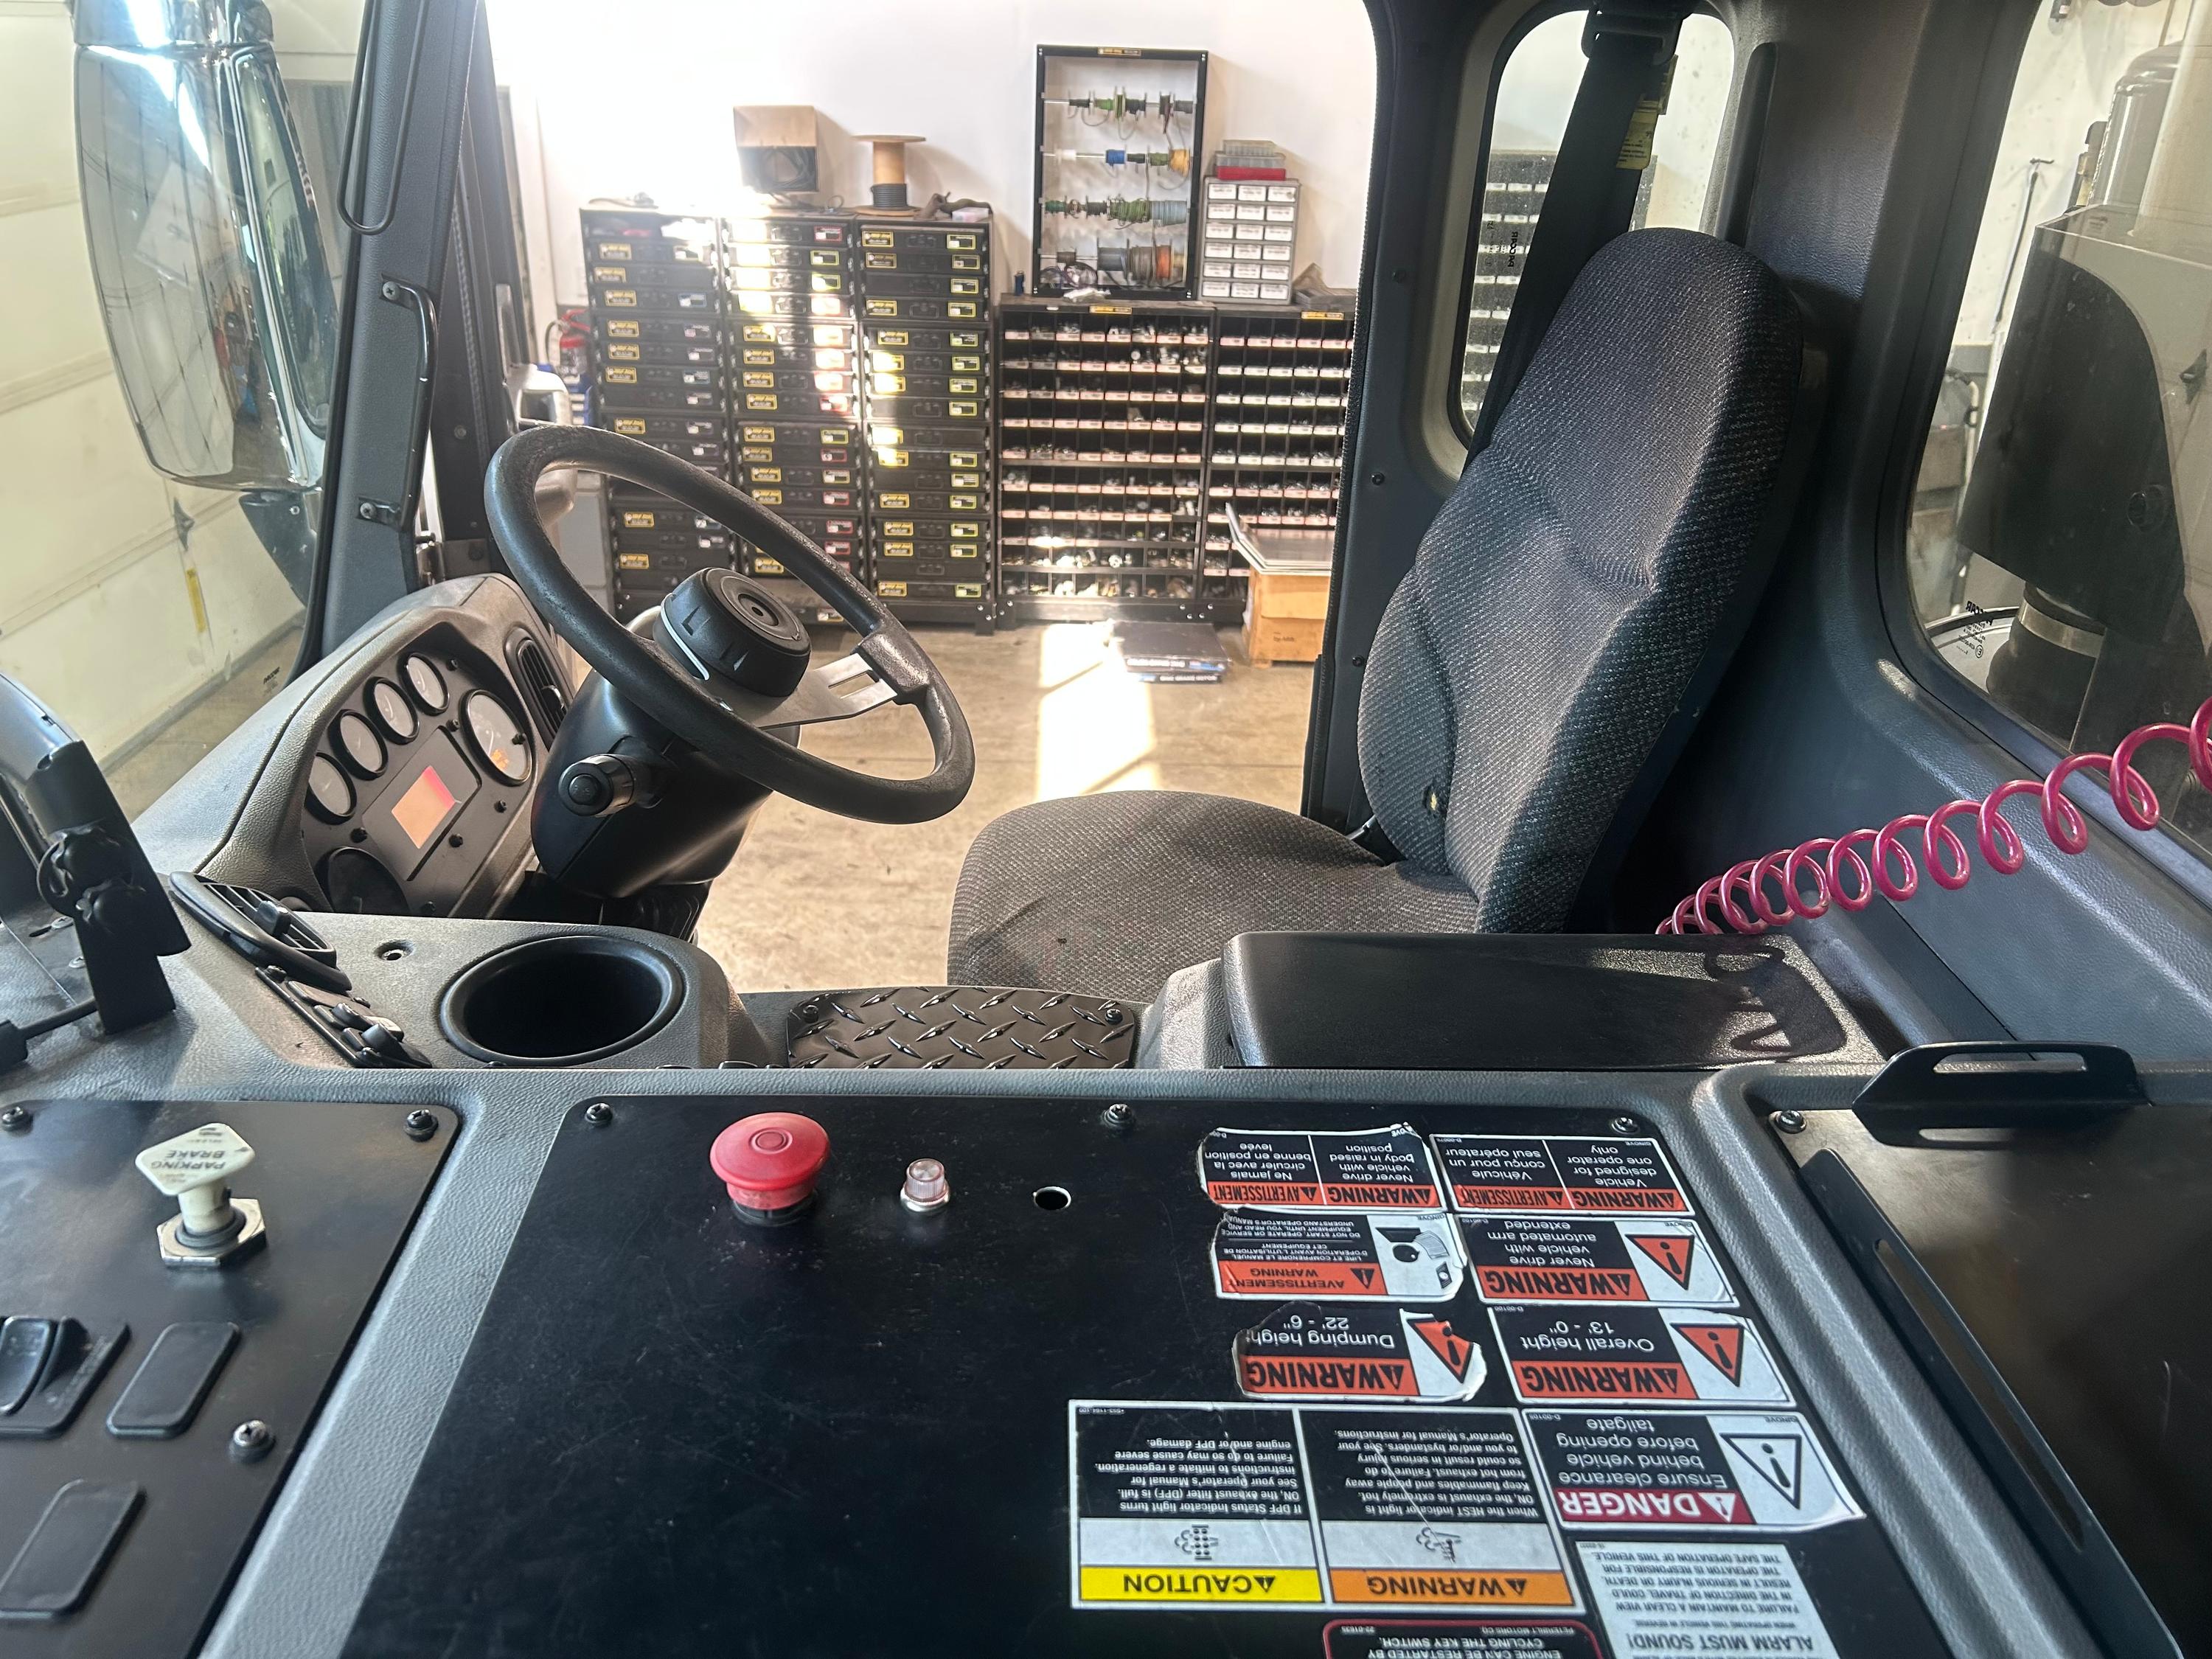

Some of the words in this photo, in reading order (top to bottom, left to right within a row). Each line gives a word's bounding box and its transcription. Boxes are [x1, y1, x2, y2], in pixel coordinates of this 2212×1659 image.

[1240, 1144, 1273, 1152] levée
[1346, 1144, 1393, 1153] position
[1591, 1145, 1618, 1155] only
[164, 1150, 225, 1158] BRAKE
[1273, 1153, 1312, 1161] benne
[1329, 1153, 1367, 1162] raised
[1369, 1152, 1382, 1163] in
[1385, 1154, 1415, 1164] body
[1446, 1150, 1510, 1158] opérateur
[1568, 1153, 1624, 1164] operator
[151, 1161, 226, 1169] PARKING
[1214, 1162, 1225, 1170] la
[1470, 1156, 1501, 1167] pour
[1504, 1157, 1545, 1168] conçu
[1262, 1163, 1306, 1171] circuler
[1367, 1164, 1411, 1172] vehicle
[1574, 1167, 1593, 1176] for
[1594, 1166, 1658, 1177] designed
[1231, 1171, 1271, 1180] jamais
[1274, 1172, 1293, 1180] Ne
[1343, 1173, 1373, 1181] drive
[1377, 1175, 1413, 1183] Never
[1472, 1171, 1532, 1180] Véhicule
[1595, 1178, 1647, 1187] Vehicle
[1214, 1186, 1300, 1202] AVERTISSEMENT
[1327, 1187, 1419, 1204] WARNING
[1461, 1189, 1549, 1206] AVERTISSEMENT
[1571, 1192, 1666, 1208] WARNING
[1504, 1220, 1571, 1231] extended
[1487, 1232, 1516, 1240] arm
[1520, 1233, 1597, 1242] automated
[1505, 1245, 1535, 1254] with
[1538, 1245, 1590, 1255] vehicle
[1509, 1256, 1546, 1266] drive
[1551, 1258, 1596, 1267] Never
[1251, 1269, 1319, 1277] WARNING
[1230, 1279, 1345, 1289] AVERTISSEMENT
[1484, 1271, 1617, 1295] WARNING
[1308, 1329, 1395, 1349] Dumping
[1520, 1335, 1582, 1351] height
[1585, 1338, 1655, 1352] Overall
[1245, 1361, 1385, 1390] WARNING
[1520, 1366, 1663, 1394] WARNING
[1587, 1416, 1655, 1433] tailgate
[1335, 1430, 1399, 1440] instructions.
[1402, 1432, 1417, 1441] for
[1419, 1433, 1458, 1442] Manual
[1147, 1439, 1192, 1449] damage.
[1195, 1441, 1216, 1450] DPF
[1219, 1441, 1253, 1450] and/or
[1256, 1440, 1291, 1450] engine
[1338, 1441, 1362, 1450] your
[1557, 1433, 1632, 1448] opening
[1638, 1437, 1700, 1451] before
[1364, 1443, 1384, 1451] See
[1385, 1444, 1447, 1453] bystanders.
[1449, 1444, 1483, 1453] and/or
[1485, 1444, 1505, 1453] you
[1506, 1446, 1518, 1455] to
[1115, 1452, 1150, 1461] severe
[1152, 1452, 1185, 1461] cause
[1187, 1451, 1210, 1461] may
[1212, 1453, 1225, 1461] so
[1228, 1453, 1242, 1462] do
[1244, 1453, 1255, 1462] to
[1257, 1453, 1294, 1462] Failure
[1358, 1453, 1389, 1466] injury
[1391, 1455, 1430, 1464] serious
[1431, 1456, 1442, 1465] in
[1444, 1457, 1475, 1465] result
[1567, 1454, 1635, 1468] vehicle
[1477, 1457, 1506, 1466] could
[1638, 1455, 1705, 1470] behind
[1096, 1463, 1166, 1473] regeneration.
[1169, 1464, 1176, 1473] a
[1178, 1465, 1216, 1474] initiate
[1218, 1465, 1230, 1475] to
[1231, 1465, 1295, 1475] instructions
[1365, 1467, 1379, 1477] do
[1394, 1468, 1432, 1478] Failure
[1433, 1469, 1478, 1478] exhaust.
[1480, 1470, 1499, 1478] hot
[1500, 1470, 1526, 1479] from
[1559, 1472, 1653, 1485] clearance
[1131, 1477, 1147, 1486] for
[1150, 1477, 1189, 1487] Manual
[1251, 1477, 1275, 1487] your
[1278, 1478, 1298, 1488] See
[1346, 1478, 1374, 1488] away
[1377, 1478, 1413, 1491] people
[1415, 1481, 1435, 1489] and
[1438, 1481, 1501, 1491] flammables
[1658, 1474, 1728, 1488] Ensure
[1503, 1481, 1531, 1492] Keep
[1119, 1489, 1139, 1500] full.
[1141, 1489, 1152, 1499] is
[1155, 1489, 1184, 1500] (DPF)
[1186, 1490, 1213, 1500] filter
[1215, 1490, 1259, 1500] exhaust
[1261, 1491, 1279, 1501] the
[1281, 1488, 1300, 1501] ON,
[1358, 1492, 1380, 1502] hot.
[1382, 1491, 1436, 1503] extremely
[1437, 1494, 1448, 1503] is
[1450, 1494, 1493, 1503] exhaust
[1514, 1494, 1534, 1504] ON,
[1495, 1495, 1514, 1504] the
[1557, 1492, 1701, 1517] DANGER
[1120, 1503, 1150, 1512] turns
[1152, 1501, 1177, 1513] light
[1180, 1503, 1229, 1514] Indicator
[1231, 1503, 1267, 1514] Status
[1270, 1504, 1291, 1514] DPF
[1294, 1505, 1302, 1514] If
[1366, 1506, 1376, 1515] is
[1377, 1504, 1403, 1516] light
[1406, 1504, 1454, 1517] indicator
[1457, 1507, 1485, 1517] HEST
[1487, 1507, 1506, 1517] the
[1506, 1508, 1539, 1517] When
[1124, 1575, 1252, 1593] CAUTION
[1367, 1577, 1506, 1597] WARNING
[1380, 1638, 1431, 1648] SWITCH.
[1434, 1638, 1460, 1648] KEY
[1461, 1638, 1487, 1648] THE
[1489, 1638, 1544, 1649] CYCLING
[1627, 1635, 1694, 1650] SOUND!
[1700, 1635, 1750, 1651] MUST
[1751, 1636, 1814, 1652] ALARM
[1368, 1649, 1385, 1658] BY
[1388, 1650, 1463, 1659] RESTARTED
[1465, 1651, 1484, 1659] BE
[1485, 1651, 1512, 1659] CAN
[1514, 1650, 1562, 1659] ENGINE
